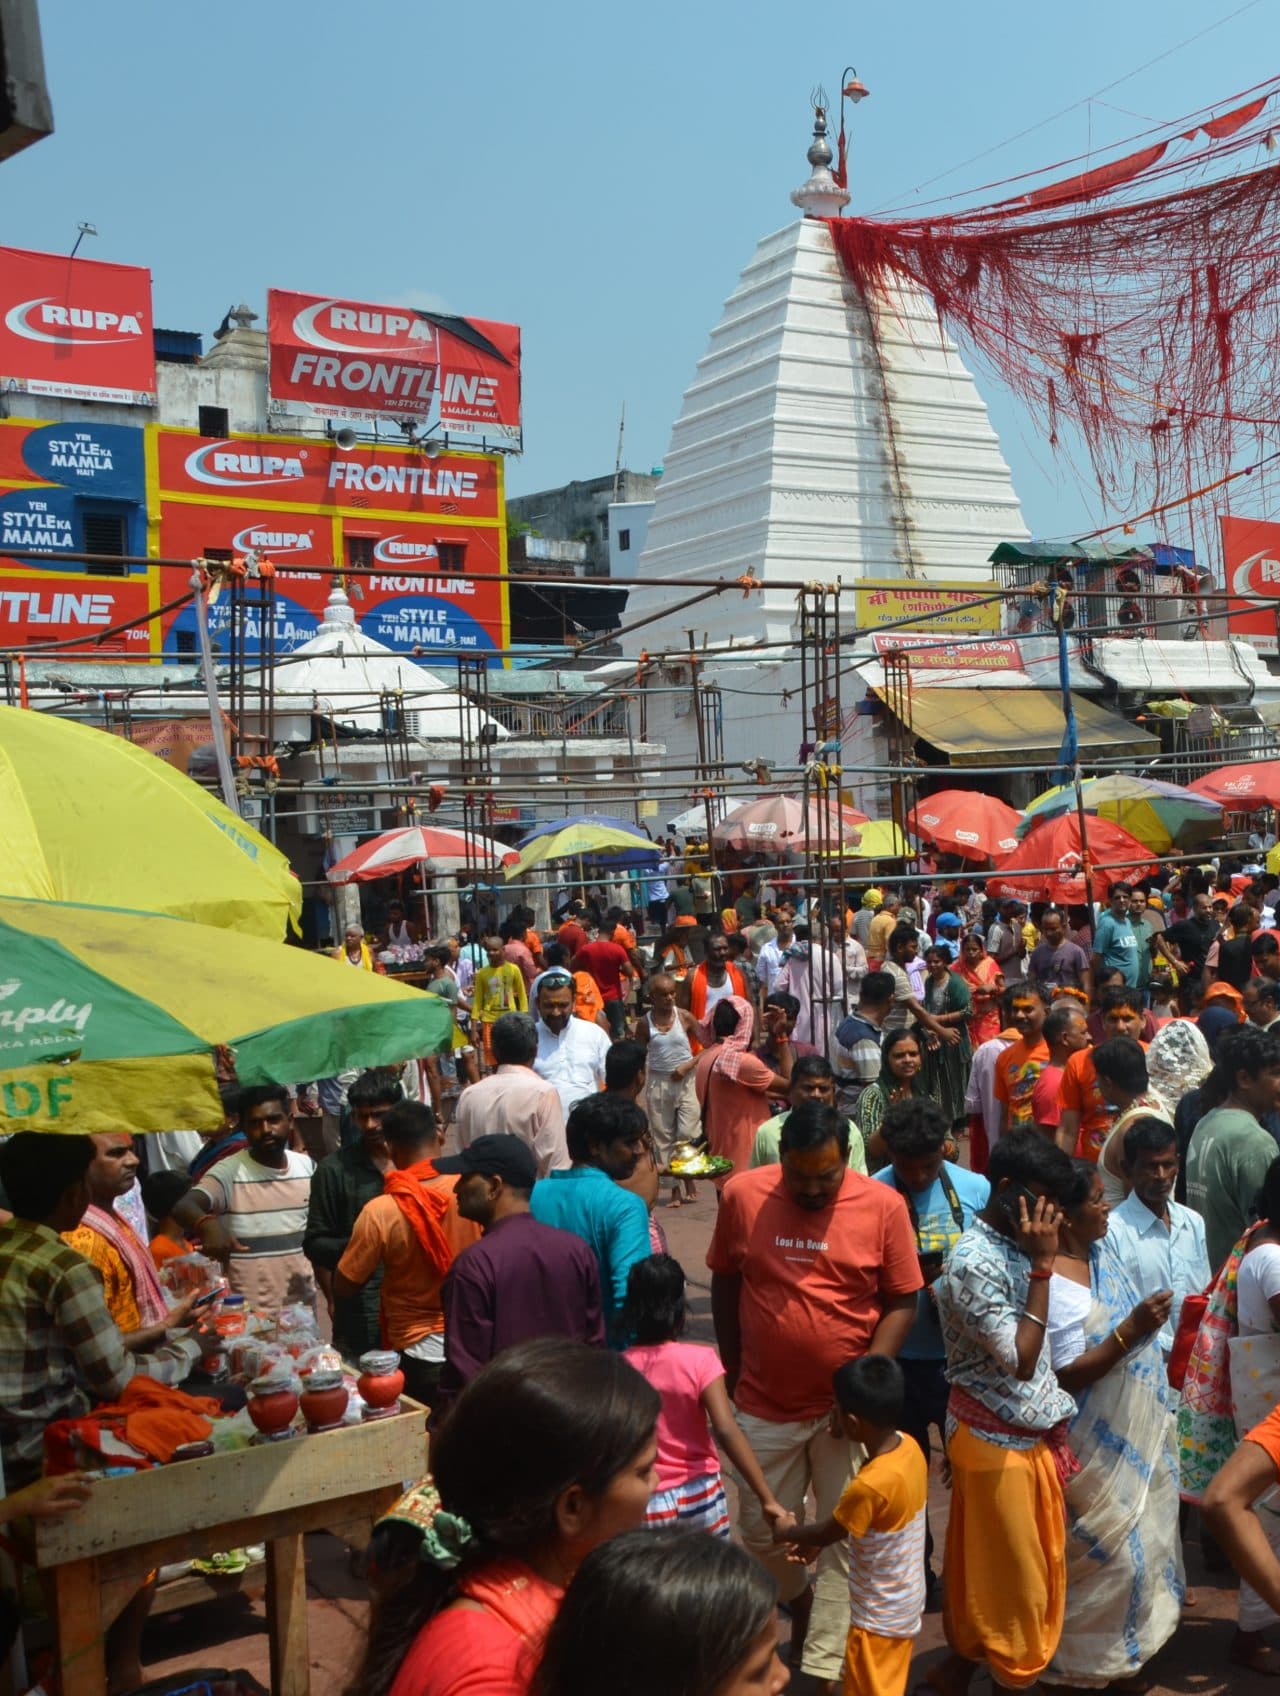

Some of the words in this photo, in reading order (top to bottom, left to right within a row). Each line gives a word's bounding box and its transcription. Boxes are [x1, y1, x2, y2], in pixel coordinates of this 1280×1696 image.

[41, 304, 143, 335] RUPA
[330, 307, 433, 341] RUPA
[290, 353, 499, 406] FRONTLINE
[447, 407, 481, 418] MAMLA
[75, 433, 91, 441] YEH
[48, 440, 101, 456] STYLE
[100, 448, 112, 457] KA
[51, 454, 113, 470] MAMLA
[214, 453, 304, 477] RUPA
[328, 461, 479, 499] FRONTLINE
[28, 501, 47, 511] YEH
[3, 511, 56, 529] STYLE
[56, 519, 71, 530] KA
[3, 529, 74, 547] MAMLA
[251, 531, 312, 550] RUPA
[388, 541, 439, 557] RUPA
[0, 591, 115, 624] TLINE
[399, 608, 447, 625] STYLE
[378, 625, 393, 634] KA
[394, 625, 456, 644] MAMLA
[775, 1235, 793, 1248] Lost
[796, 1237, 804, 1249] in
